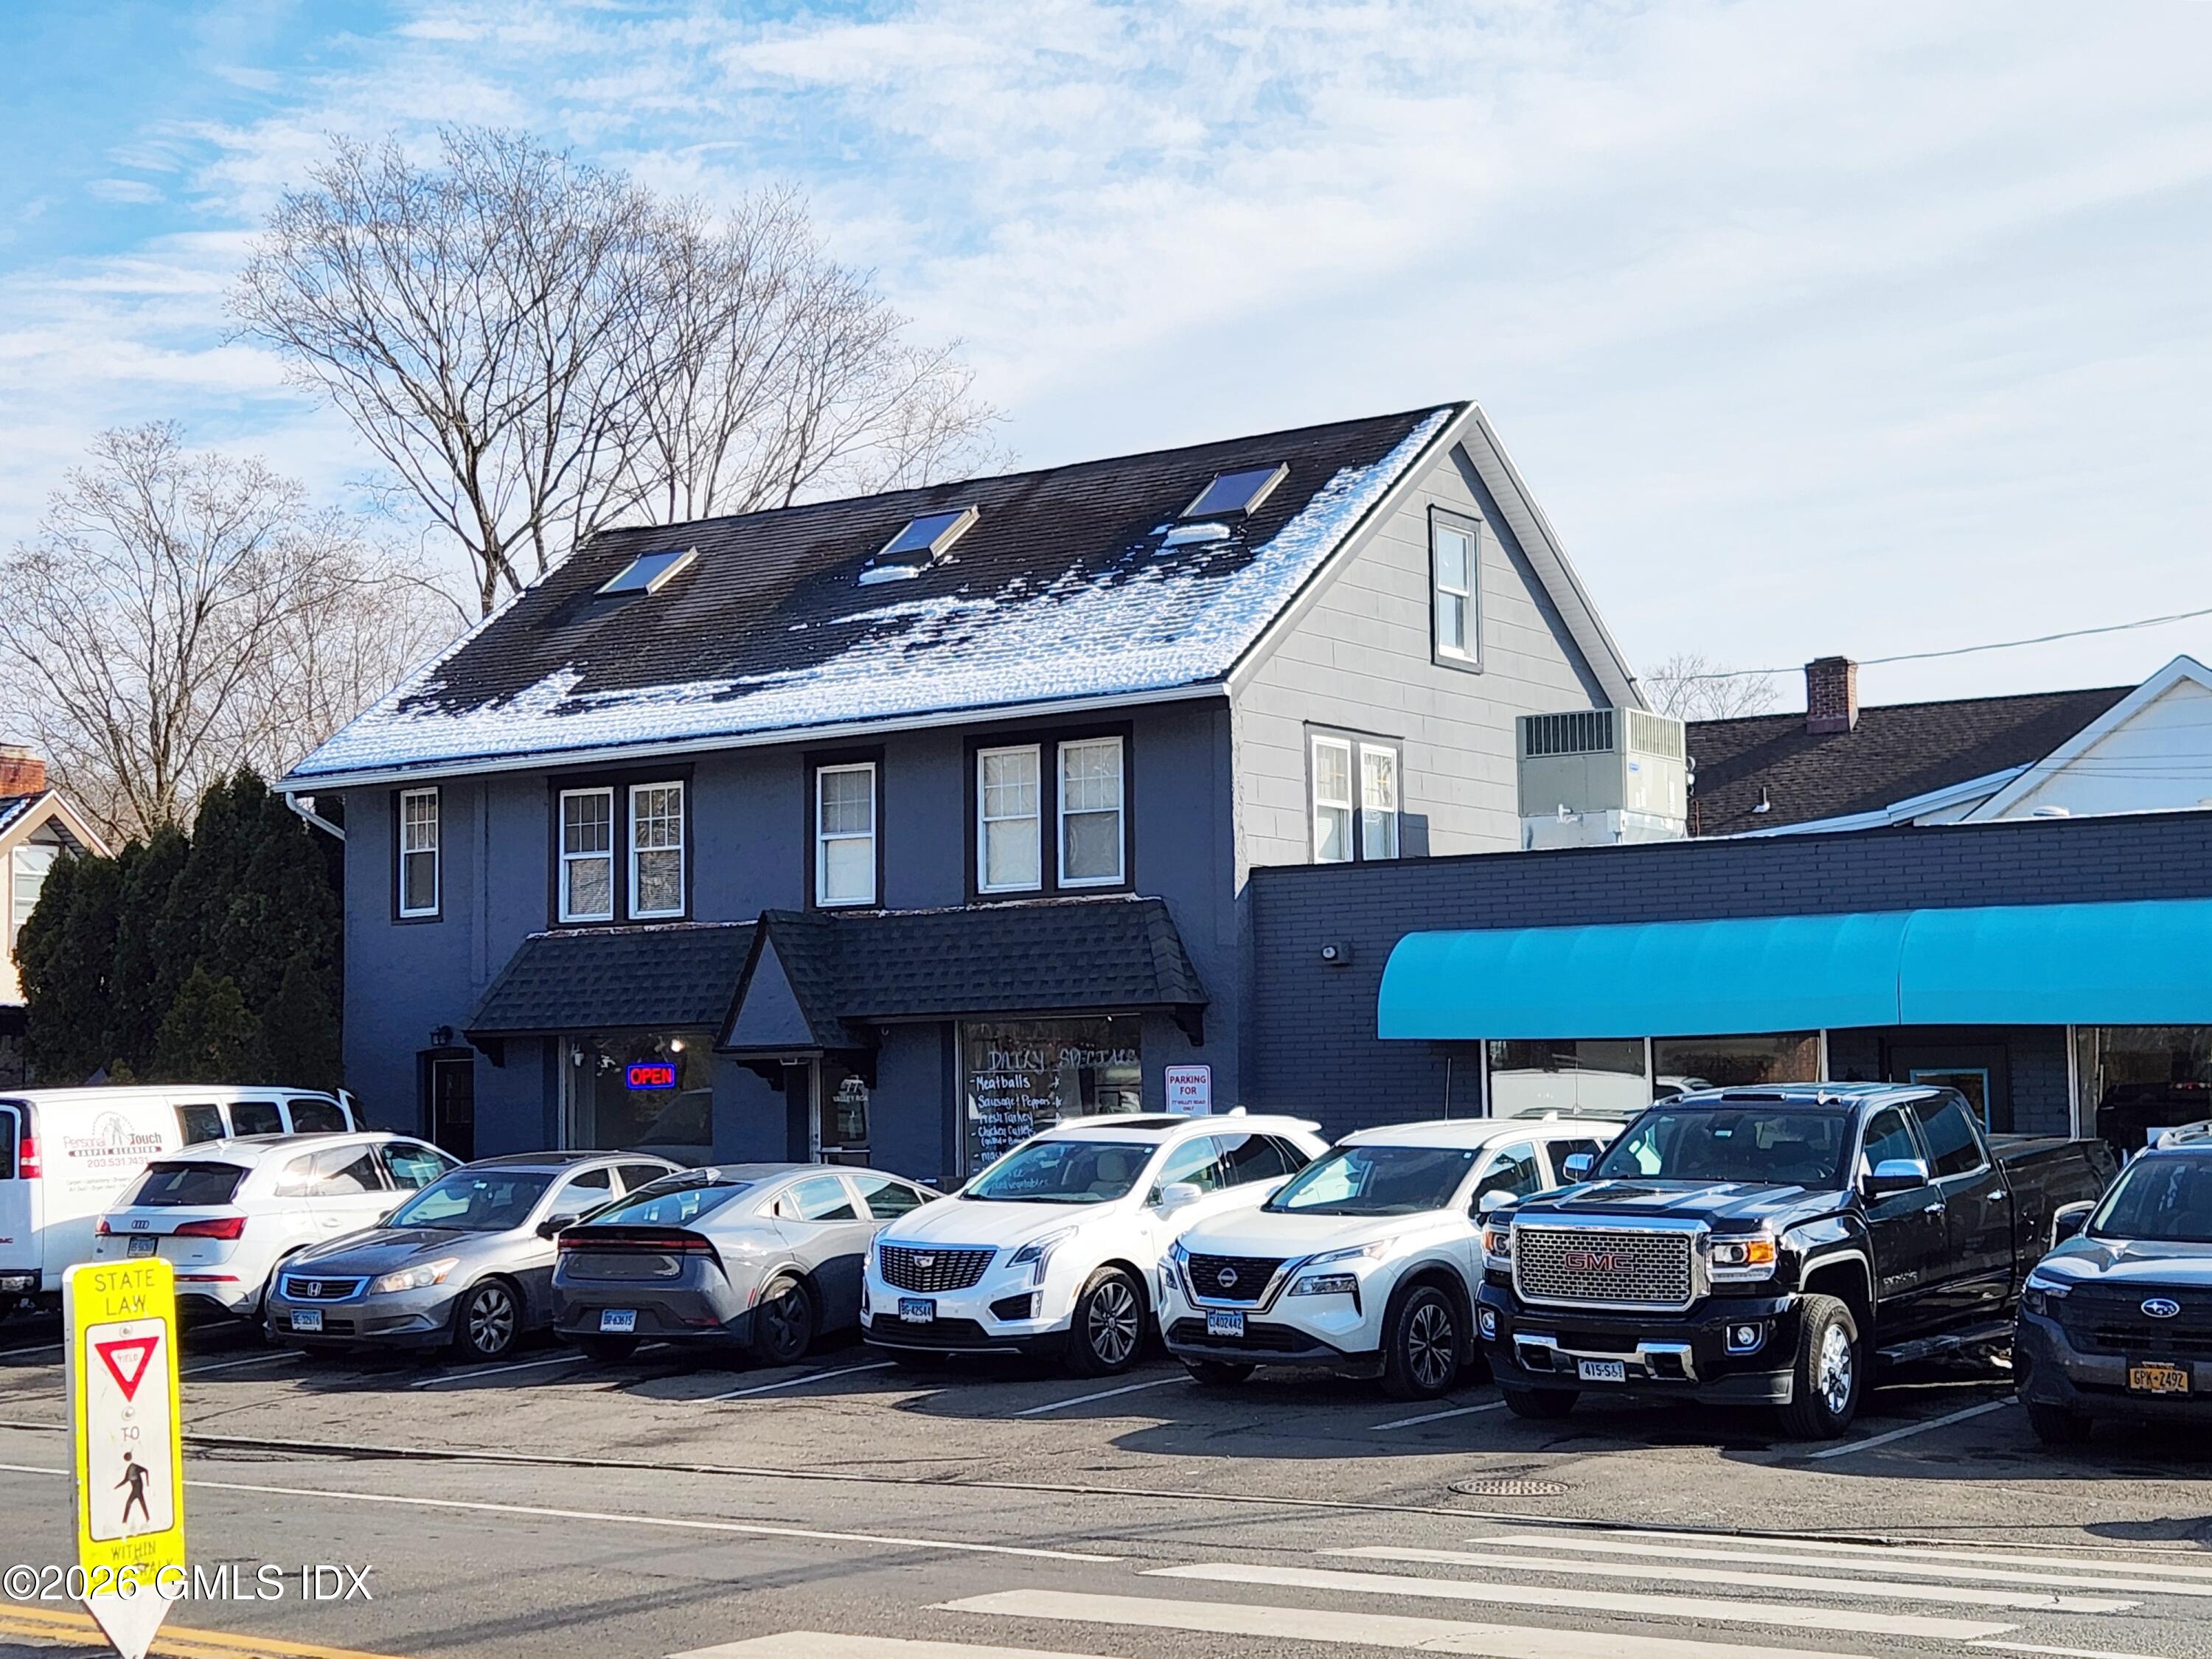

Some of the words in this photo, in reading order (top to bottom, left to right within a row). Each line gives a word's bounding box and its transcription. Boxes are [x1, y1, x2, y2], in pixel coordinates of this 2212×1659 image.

[988, 1050, 1045, 1074] DAILY
[1060, 1048, 1135, 1067] SPECIALS
[630, 1068, 672, 1085] OPEN
[976, 1073, 1031, 1091] Meatballs
[1169, 1075, 1206, 1084] PARKING
[1180, 1086, 1197, 1095] FOR
[63, 1135, 106, 1149] Personal
[128, 1132, 162, 1145] Touch
[1564, 1251, 1635, 1272] GMC
[94, 1268, 156, 1293] STATE
[105, 1293, 146, 1316] LAW
[117, 1352, 139, 1363] YIELD
[120, 1425, 140, 1442] TO
[111, 1540, 156, 1561] WITHIN
